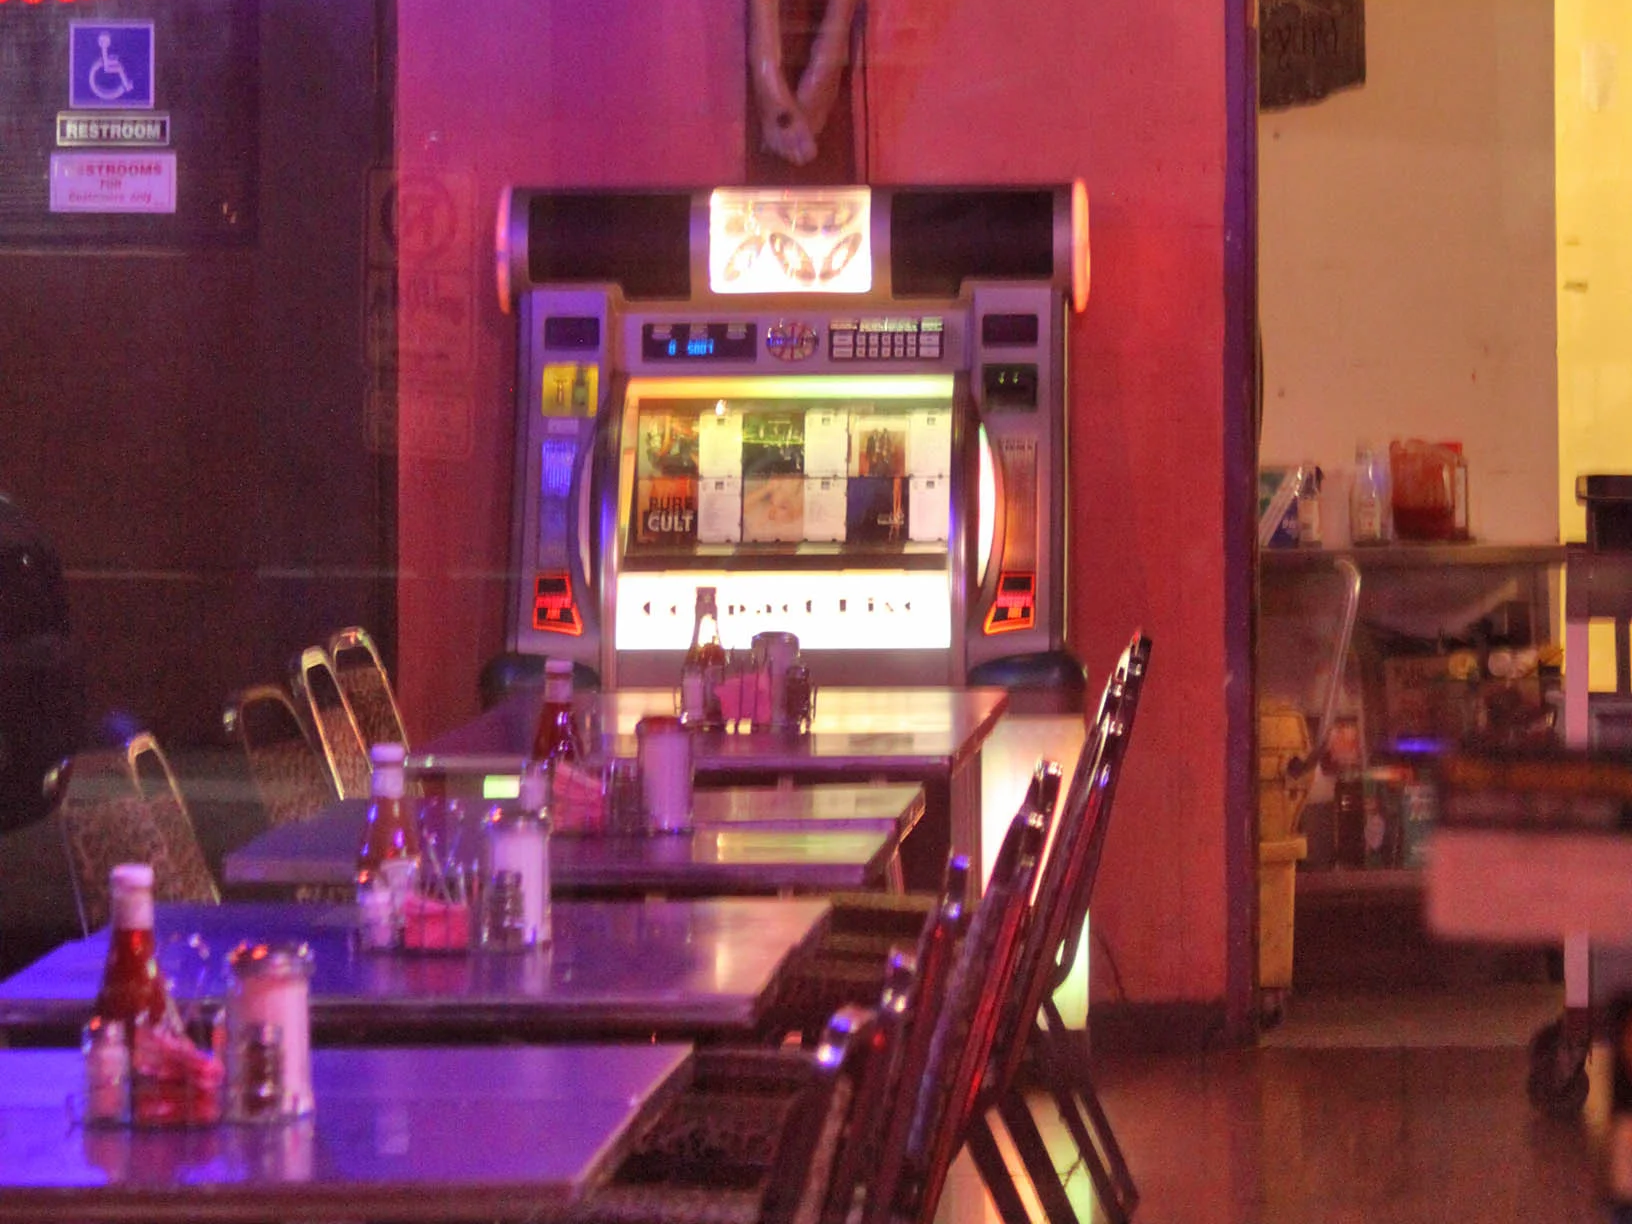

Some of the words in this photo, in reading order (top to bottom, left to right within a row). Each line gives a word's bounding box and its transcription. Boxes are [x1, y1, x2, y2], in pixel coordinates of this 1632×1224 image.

[65, 119, 161, 140] RESTROOM
[69, 163, 163, 177] STROOMS
[647, 511, 694, 533] CULT
